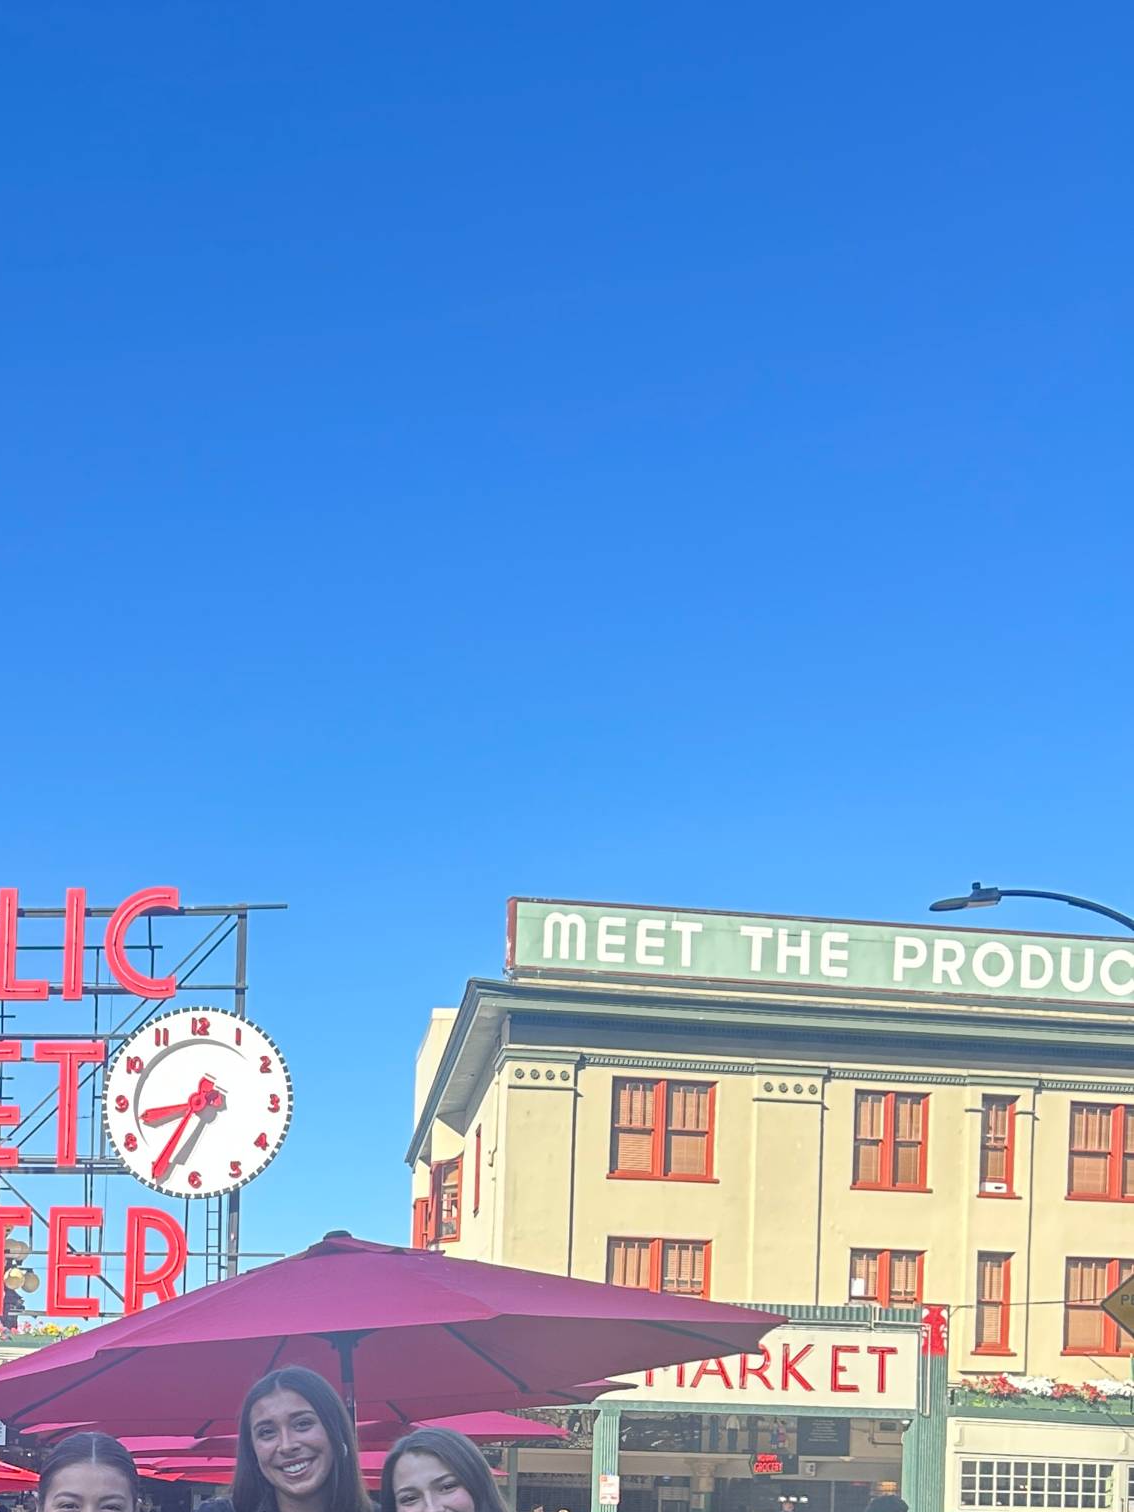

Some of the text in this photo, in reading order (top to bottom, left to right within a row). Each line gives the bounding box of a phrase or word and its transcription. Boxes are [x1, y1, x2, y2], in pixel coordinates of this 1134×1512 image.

[542, 911, 703, 968] MEET
[740, 925, 850, 979] THE
[191, 1017, 210, 1036] 12
[154, 1028, 169, 1047] 11
[235, 1027, 242, 1047] 1
[126, 1056, 144, 1074] 10
[259, 1055, 273, 1074] 2
[115, 1094, 129, 1113] 9
[267, 1093, 280, 1113] 3
[123, 1132, 138, 1152] 8
[253, 1132, 270, 1151] 4
[228, 1160, 242, 1178] 5
[187, 1170, 202, 1189] 6
